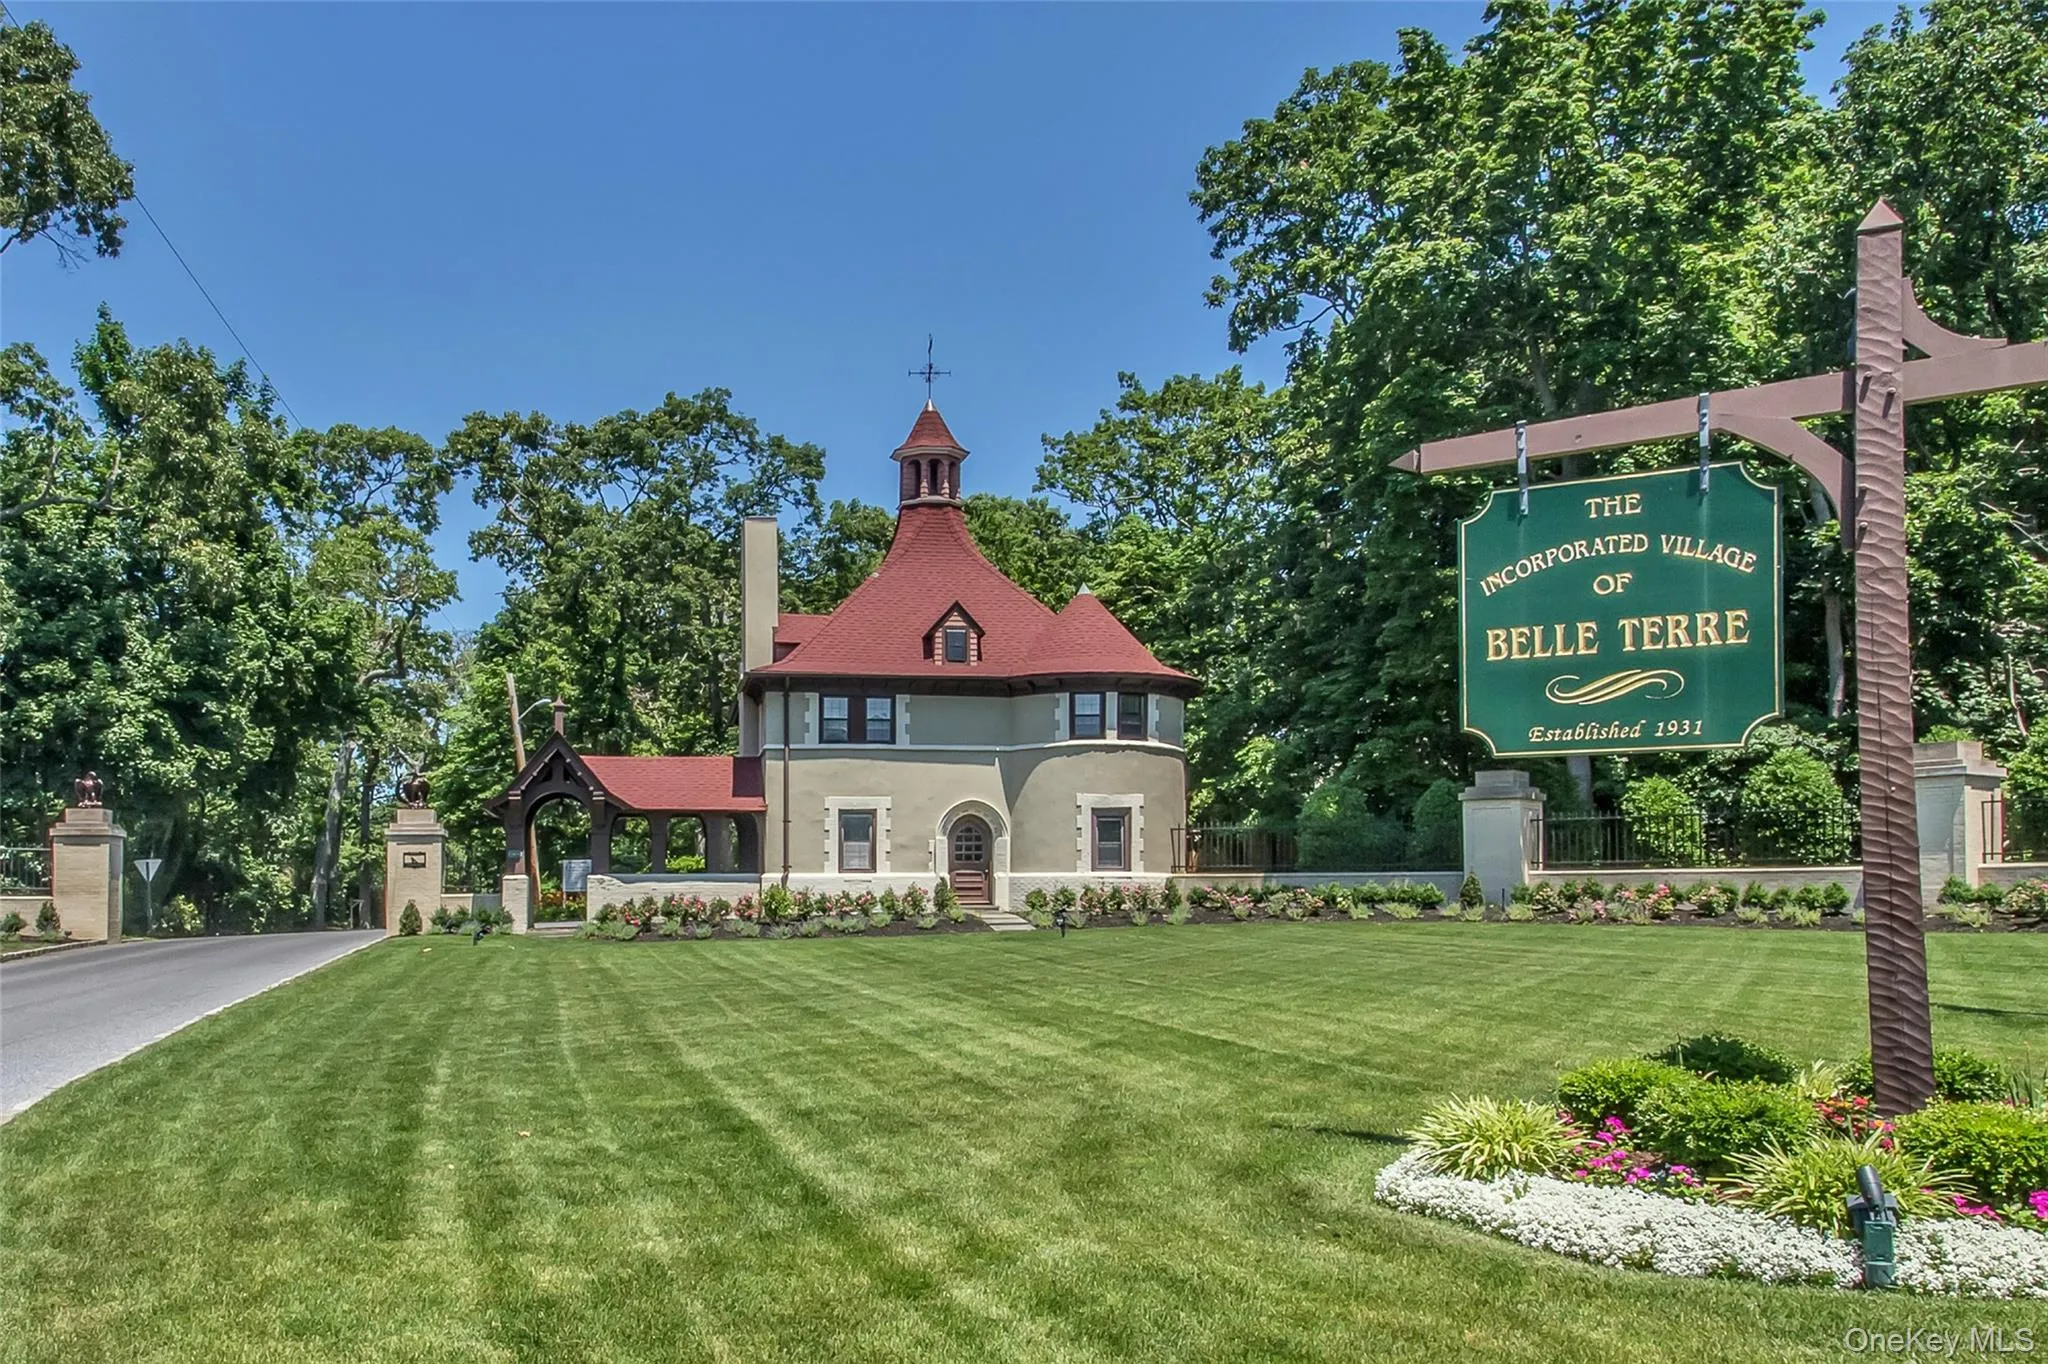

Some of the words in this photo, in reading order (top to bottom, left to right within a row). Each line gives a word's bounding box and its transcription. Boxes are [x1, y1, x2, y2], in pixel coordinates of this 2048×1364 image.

[1585, 493, 1643, 519] THE
[1480, 533, 1649, 597] INCORPORATED
[1660, 533, 1757, 574] VILLAGE
[1593, 572, 1633, 595] OF
[1485, 620, 1600, 661] BELLE
[1617, 609, 1750, 652] TERRE
[1528, 719, 1647, 743] Established
[1654, 719, 1704, 738] 1931
